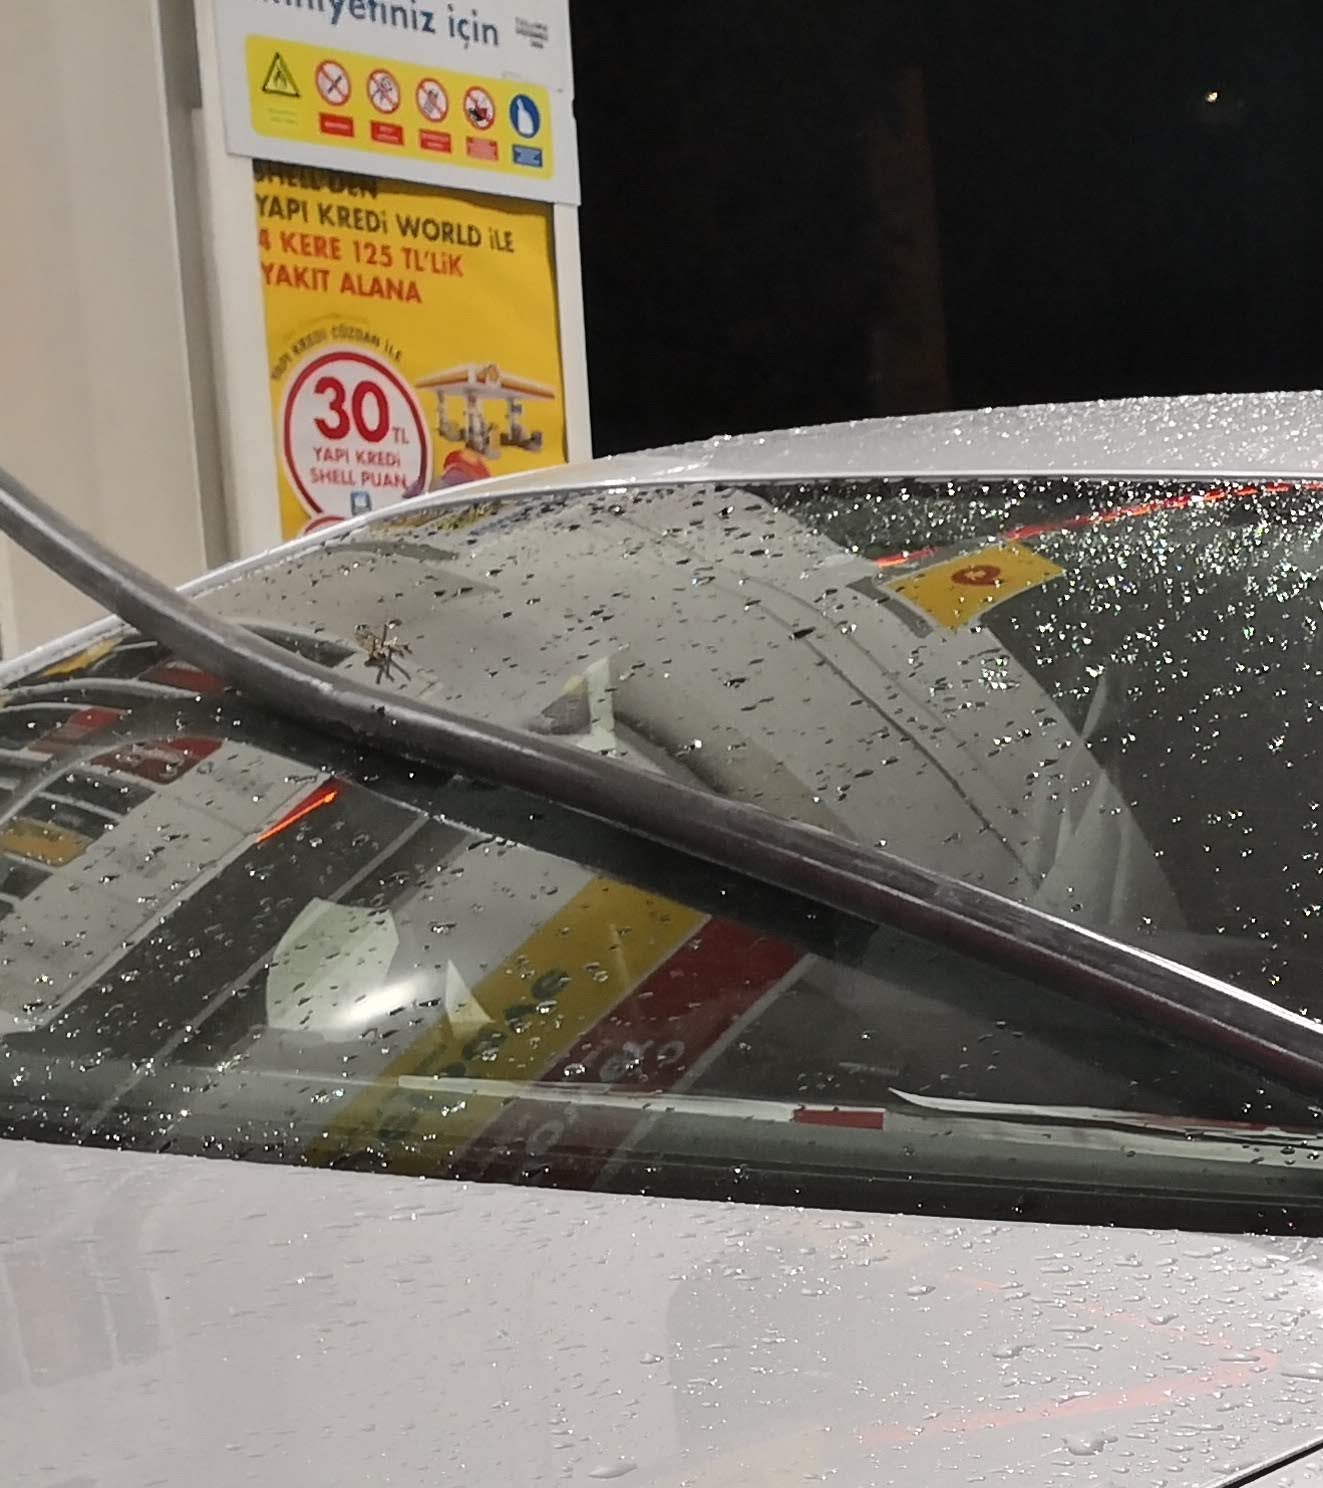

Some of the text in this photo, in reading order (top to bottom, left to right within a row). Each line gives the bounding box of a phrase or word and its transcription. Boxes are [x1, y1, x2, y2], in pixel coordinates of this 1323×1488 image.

[448, 4, 499, 49] için
[256, 193, 308, 222] YAPI
[396, 213, 481, 248] WORLD
[280, 231, 342, 260] KERE
[353, 240, 393, 268] 125
[261, 262, 423, 303] YAKIT ALANA
[314, 376, 409, 444] 30 TL
[313, 447, 349, 463] YAPI
[310, 467, 408, 489] SHELL PUAN
